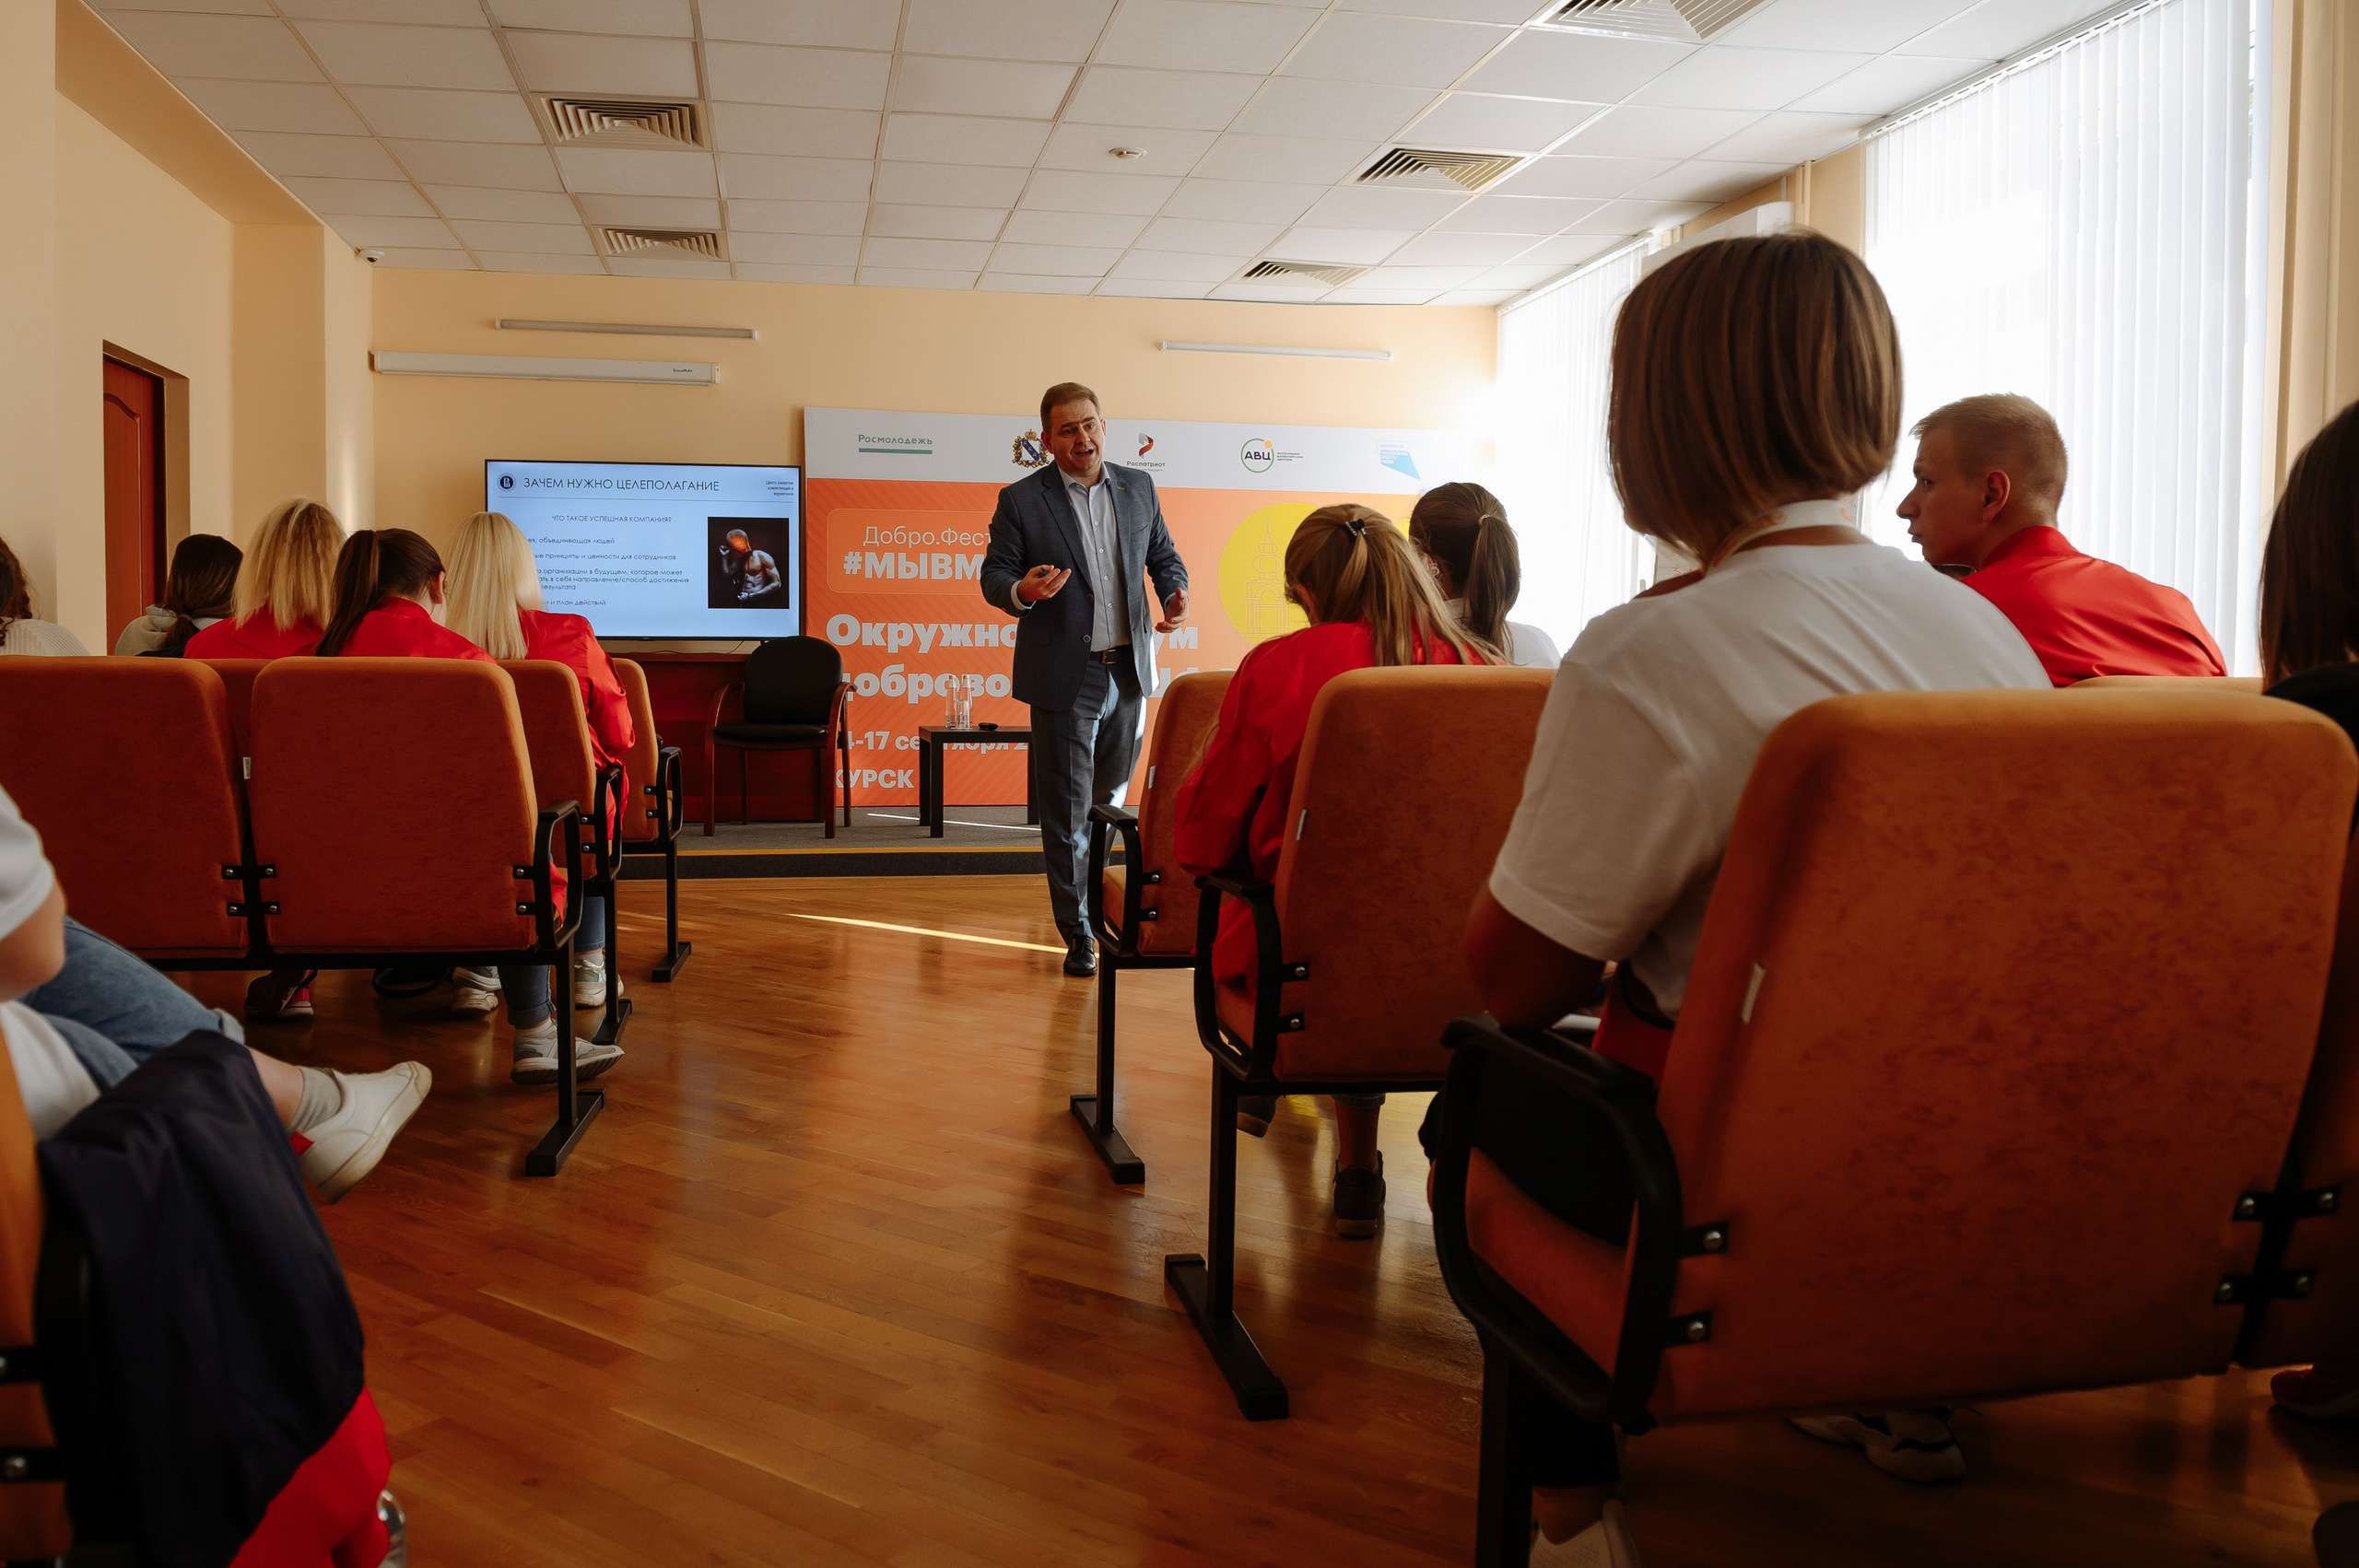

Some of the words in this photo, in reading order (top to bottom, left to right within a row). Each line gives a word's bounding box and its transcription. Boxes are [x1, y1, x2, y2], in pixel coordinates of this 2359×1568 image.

[858, 434, 933, 445] Росмолодежь
[1244, 451, 1272, 461] АВЦ
[523, 477, 564, 488] ЗАЧЕМ
[567, 478, 613, 489] НУЖНО
[616, 479, 720, 491] ЦЕЛЕПОЛАГАНИЕ
[538, 536, 592, 544] объединяющая
[843, 551, 985, 580] #МЫВМ
[593, 568, 629, 576] будущем,
[572, 576, 648, 584] направление/способ
[826, 614, 1017, 654] Окружно
